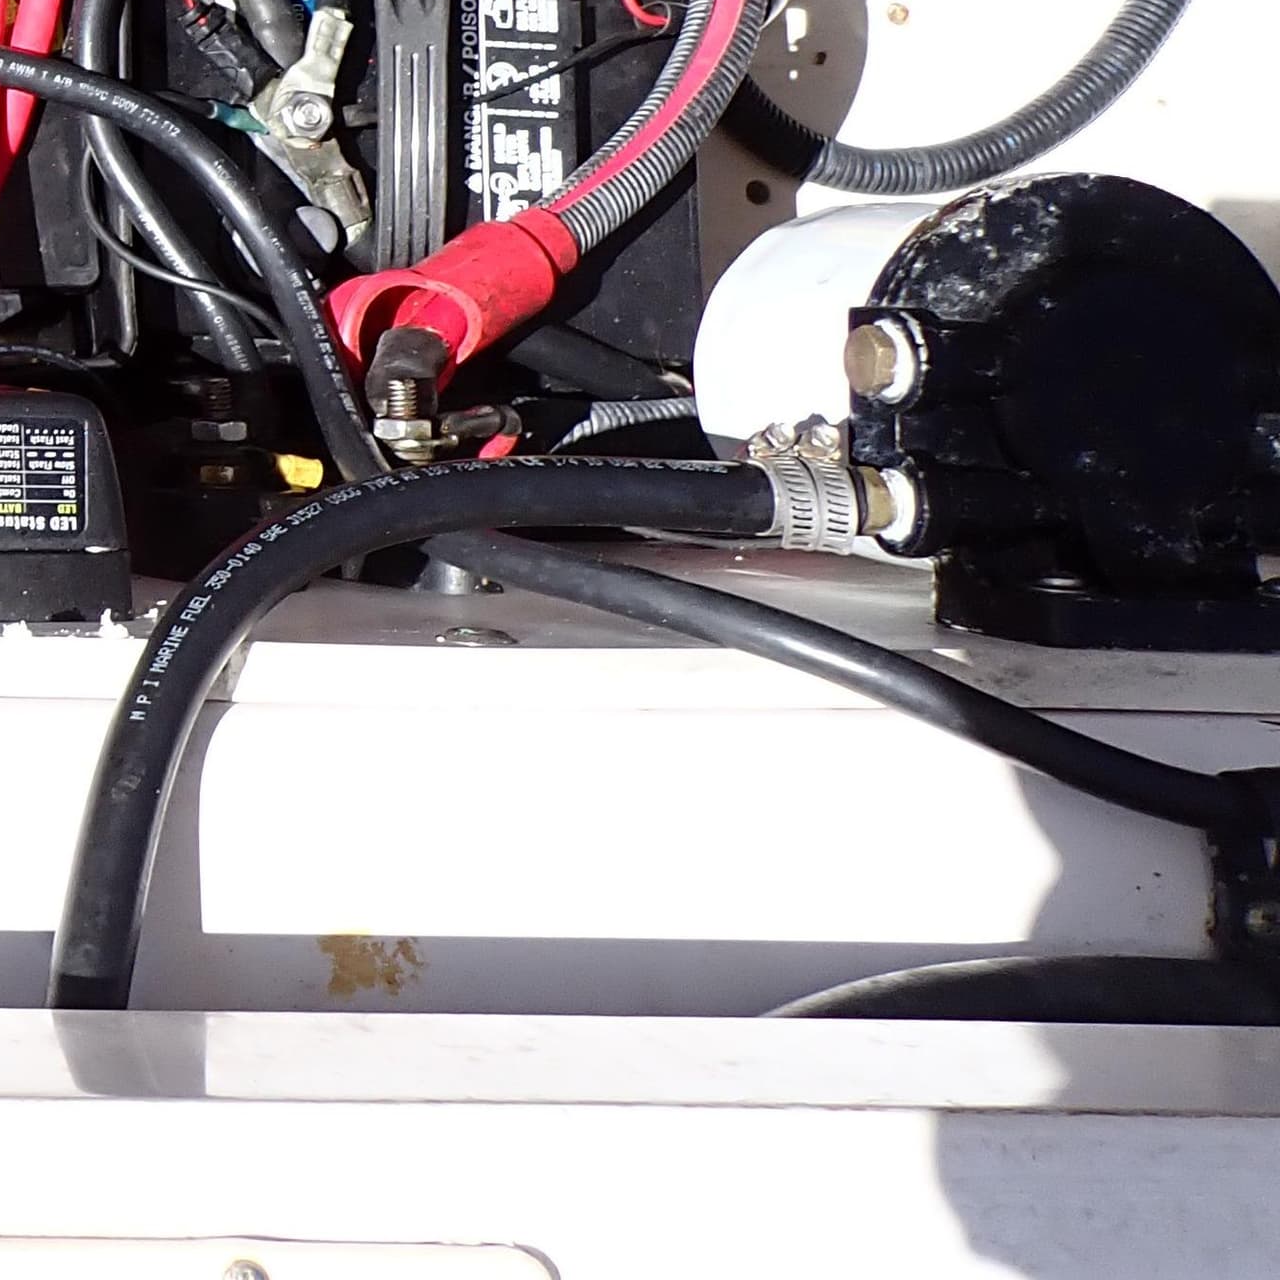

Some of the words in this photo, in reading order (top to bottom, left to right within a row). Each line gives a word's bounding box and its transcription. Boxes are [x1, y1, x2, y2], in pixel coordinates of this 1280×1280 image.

[9, 62, 36, 77] AWM
[53, 75, 73, 88] A/B
[30, 436, 53, 445] Flash
[56, 436, 74, 445] Fast
[29, 461, 52, 470] Flash
[54, 461, 75, 470] Slow
[61, 475, 75, 484] Off
[63, 489, 75, 498] On
[57, 504, 77, 513] LED
[50, 516, 77, 530] LED
[150, 624, 189, 673] MARINE
[181, 594, 212, 622] FUEL
[204, 541, 263, 590] 350-0140
[259, 523, 288, 542] SAE
[286, 501, 324, 526] J1527
[362, 474, 400, 491] TYPE
